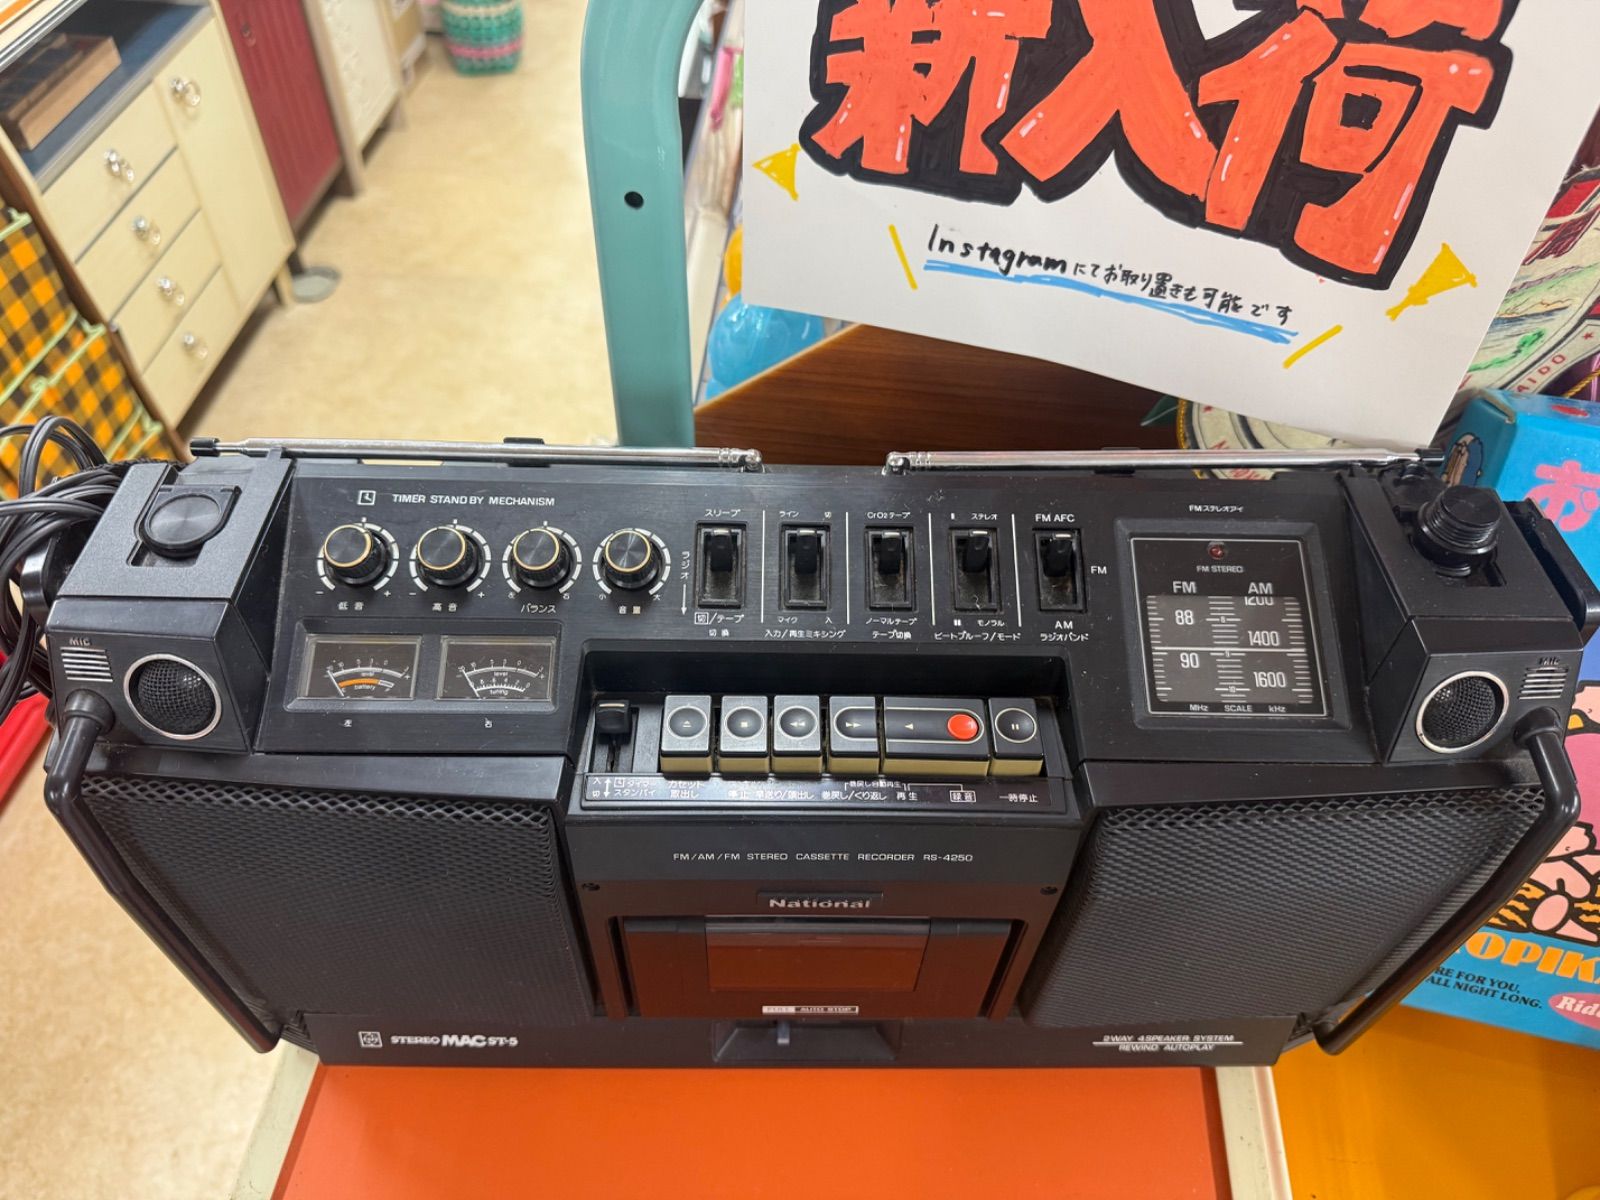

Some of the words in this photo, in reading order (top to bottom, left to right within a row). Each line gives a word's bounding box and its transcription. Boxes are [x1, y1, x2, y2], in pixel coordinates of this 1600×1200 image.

[927, 223, 1067, 275] Instagram
[392, 493, 426, 504] TIMER
[488, 496, 555, 506] MECHANISM
[704, 508, 741, 517] スリープ
[970, 512, 998, 521] ステレオ
[1035, 513, 1051, 522] FM
[1053, 514, 1076, 523] AFC
[680, 550, 691, 581] ラジオ
[1091, 566, 1107, 575] FM
[1196, 565, 1209, 573] FM
[1172, 581, 1197, 594] FM
[1248, 582, 1273, 595] AM
[520, 602, 557, 614] バランス
[866, 617, 917, 626] ノーマルテープ
[1175, 609, 1194, 625] 88
[977, 619, 1005, 627] モノラル
[1055, 620, 1073, 629] AM
[1040, 632, 1089, 643] ラジオバンド
[1247, 630, 1280, 647] 1400
[1180, 652, 1200, 669] 90
[1253, 671, 1287, 688] 1600
[1189, 704, 1209, 712] MHz
[1224, 704, 1252, 713] SCALE
[1268, 704, 1286, 713] kHz
[614, 788, 656, 797] スタンバイ
[673, 853, 741, 861] FM/AM/FM
[746, 853, 788, 861] STEREO
[796, 853, 849, 861] CASSETTE
[858, 853, 915, 862] RECORDER
[923, 853, 974, 862] RS-4250
[769, 899, 870, 908] National
[1455, 970, 1489, 987] FOR
[1489, 978, 1521, 994] YOU.
[1452, 981, 1500, 1000] NIGHT
[1499, 993, 1543, 1009] LONG.
[391, 1035, 440, 1044] STEREO
[441, 1034, 487, 1048] MAC
[1193, 1034, 1235, 1042] SYSTEM
[1118, 1043, 1159, 1052] REWIND
[1163, 1043, 1214, 1052] AUTOPLAY
